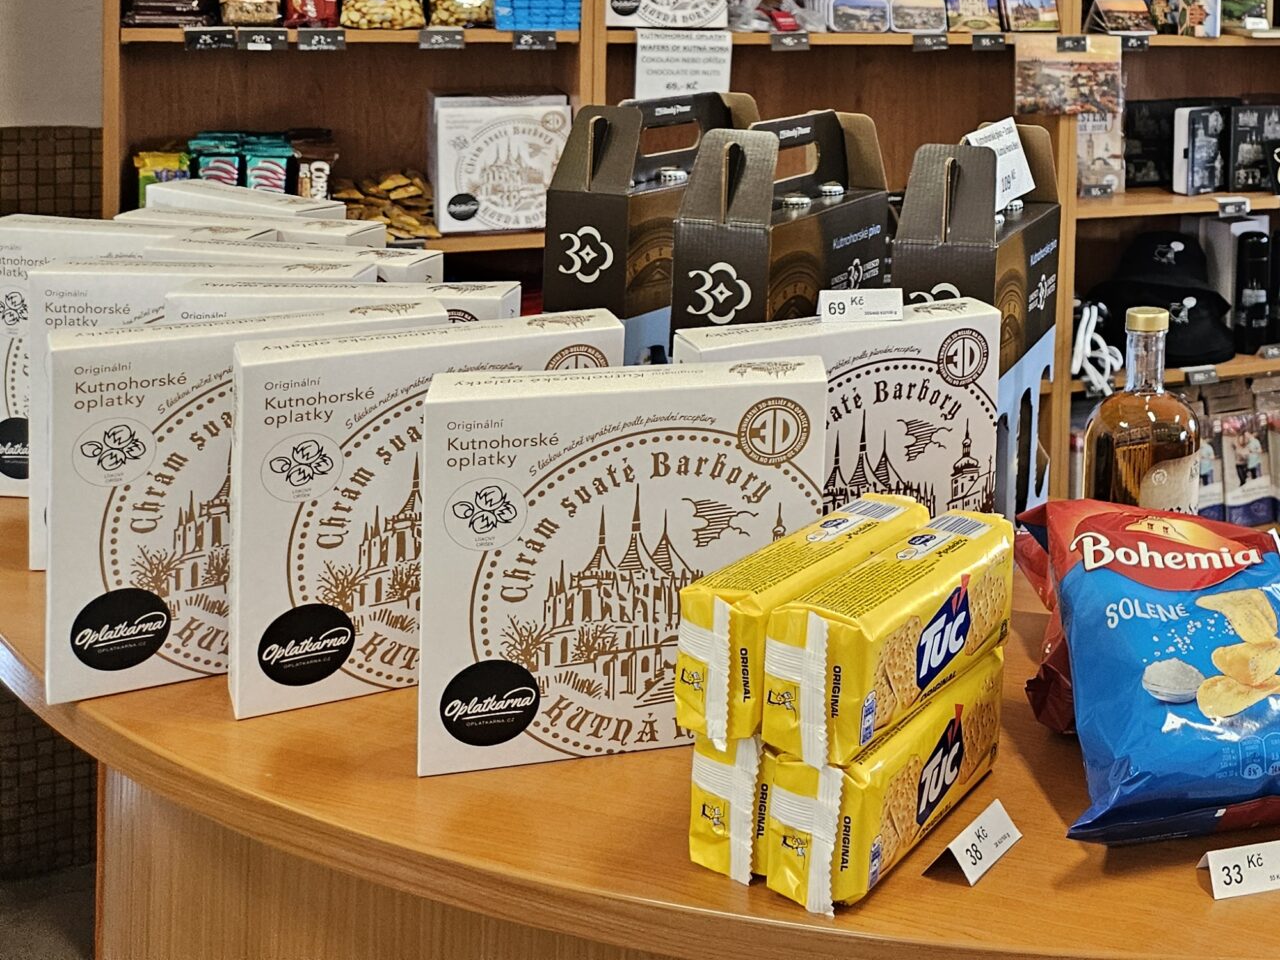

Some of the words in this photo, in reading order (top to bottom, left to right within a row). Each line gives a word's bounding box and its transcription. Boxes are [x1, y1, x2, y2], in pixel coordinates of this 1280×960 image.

[45, 302, 131, 314] Kutnohorské
[828, 302, 845, 315] 69
[851, 296, 864, 306] Kč
[74, 361, 132, 376] Originální
[75, 372, 187, 394] Kutnohorské
[264, 377, 322, 392] Originální
[74, 392, 146, 411] oplatky
[264, 387, 376, 410] Kutnohorské
[873, 378, 961, 421] Barbory
[263, 407, 334, 427] oplatky
[447, 418, 503, 430] Originální
[447, 433, 559, 451] Kutnohorské
[447, 451, 518, 468] oplatky
[130, 451, 190, 534] Chrám
[316, 465, 376, 549] Chrám
[501, 514, 560, 603] Chrám
[560, 459, 635, 518] svaté
[650, 451, 772, 503] Barbory
[1070, 533, 1263, 572] Bohemia
[1105, 597, 1190, 629] SOLENÉ
[739, 648, 751, 703] ORIGINAL
[831, 665, 842, 719] ORIGINAL
[541, 694, 659, 746] KUTNÁ
[756, 783, 768, 839] ORIGINAL
[840, 816, 851, 871] ORIGINAL
[966, 843, 983, 865] 38
[975, 826, 988, 842] Kč
[1222, 864, 1244, 887] 33
[1247, 854, 1264, 868] Kč
